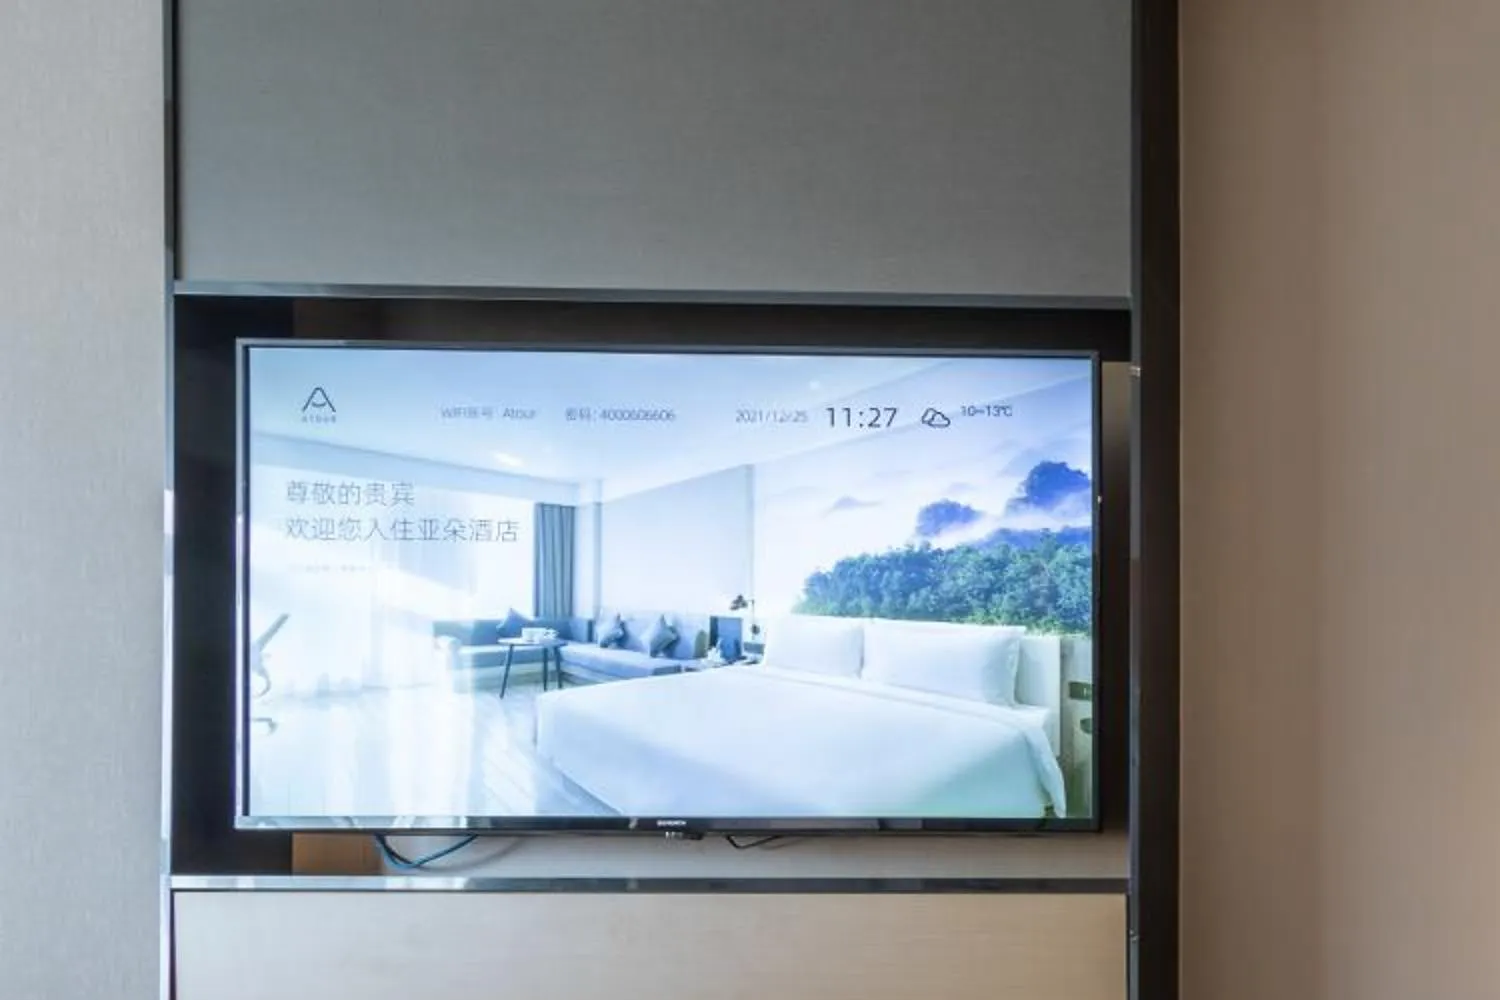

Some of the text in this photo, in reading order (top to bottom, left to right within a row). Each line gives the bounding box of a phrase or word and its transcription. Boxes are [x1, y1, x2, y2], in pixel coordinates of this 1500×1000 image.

[826, 407, 897, 428] 11:27
[287, 480, 415, 507] 尊敬的贵宾
[286, 518, 520, 542] 欢迎您入住亚朵酒店
